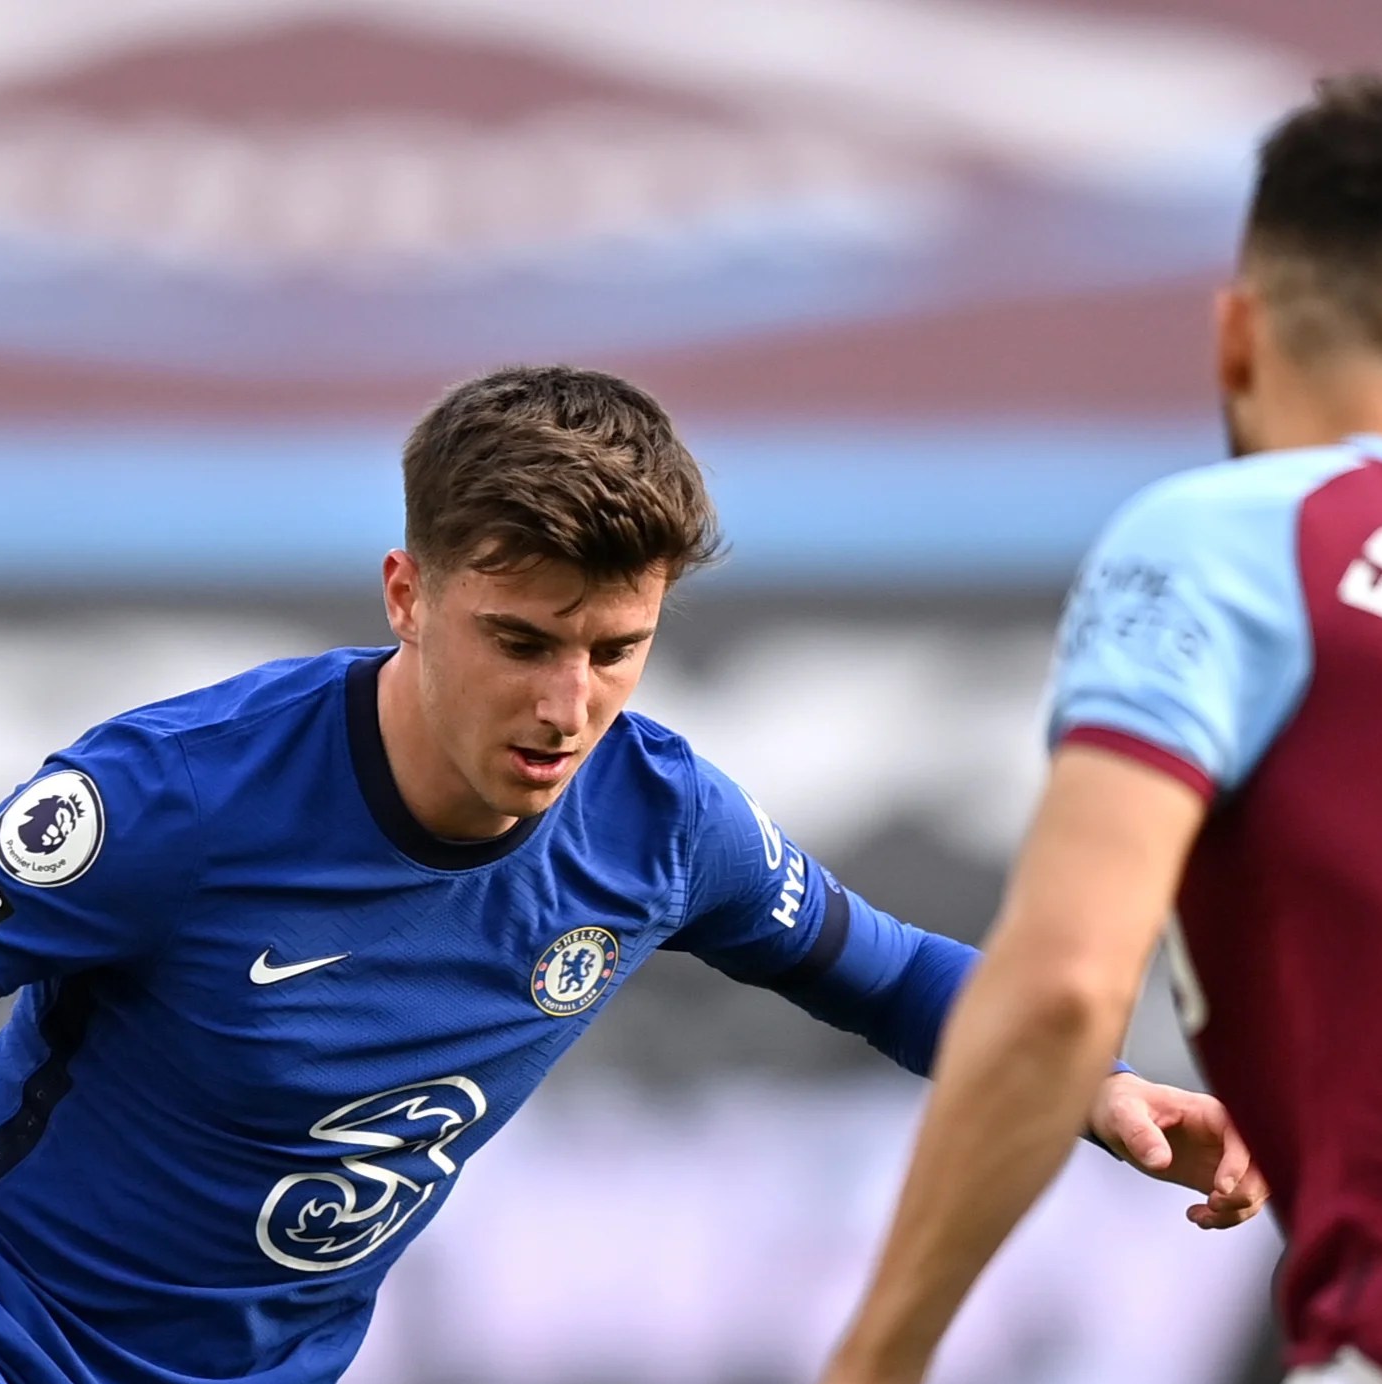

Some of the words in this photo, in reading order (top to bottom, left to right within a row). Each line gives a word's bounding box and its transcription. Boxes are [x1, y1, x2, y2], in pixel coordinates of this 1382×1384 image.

[6, 839, 31, 868] Premier
[32, 859, 66, 873] League
[554, 930, 608, 952] CHELSEA
